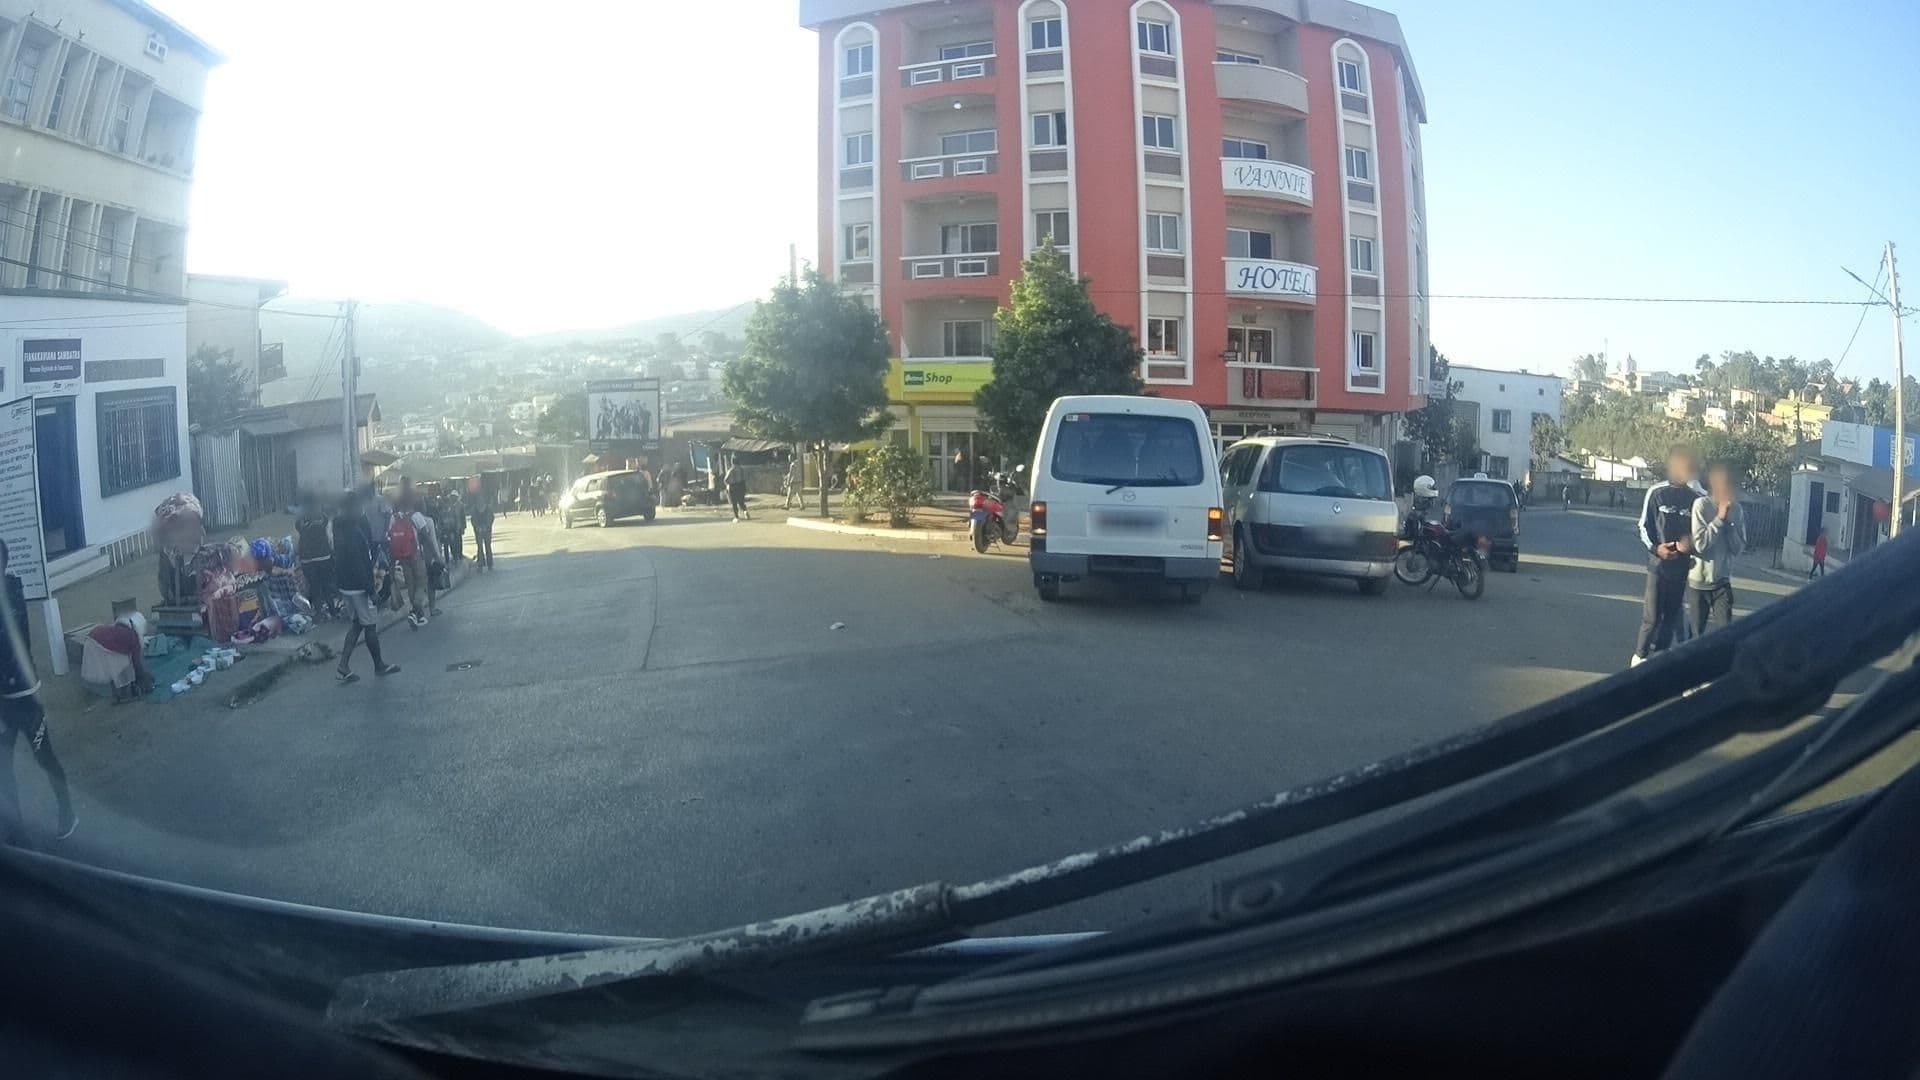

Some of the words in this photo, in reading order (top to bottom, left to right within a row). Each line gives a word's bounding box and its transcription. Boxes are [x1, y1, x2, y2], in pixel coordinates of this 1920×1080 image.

[1234, 165, 1307, 194] VANNIE
[1238, 266, 1312, 295] HOTEL
[925, 373, 952, 384] Shop
